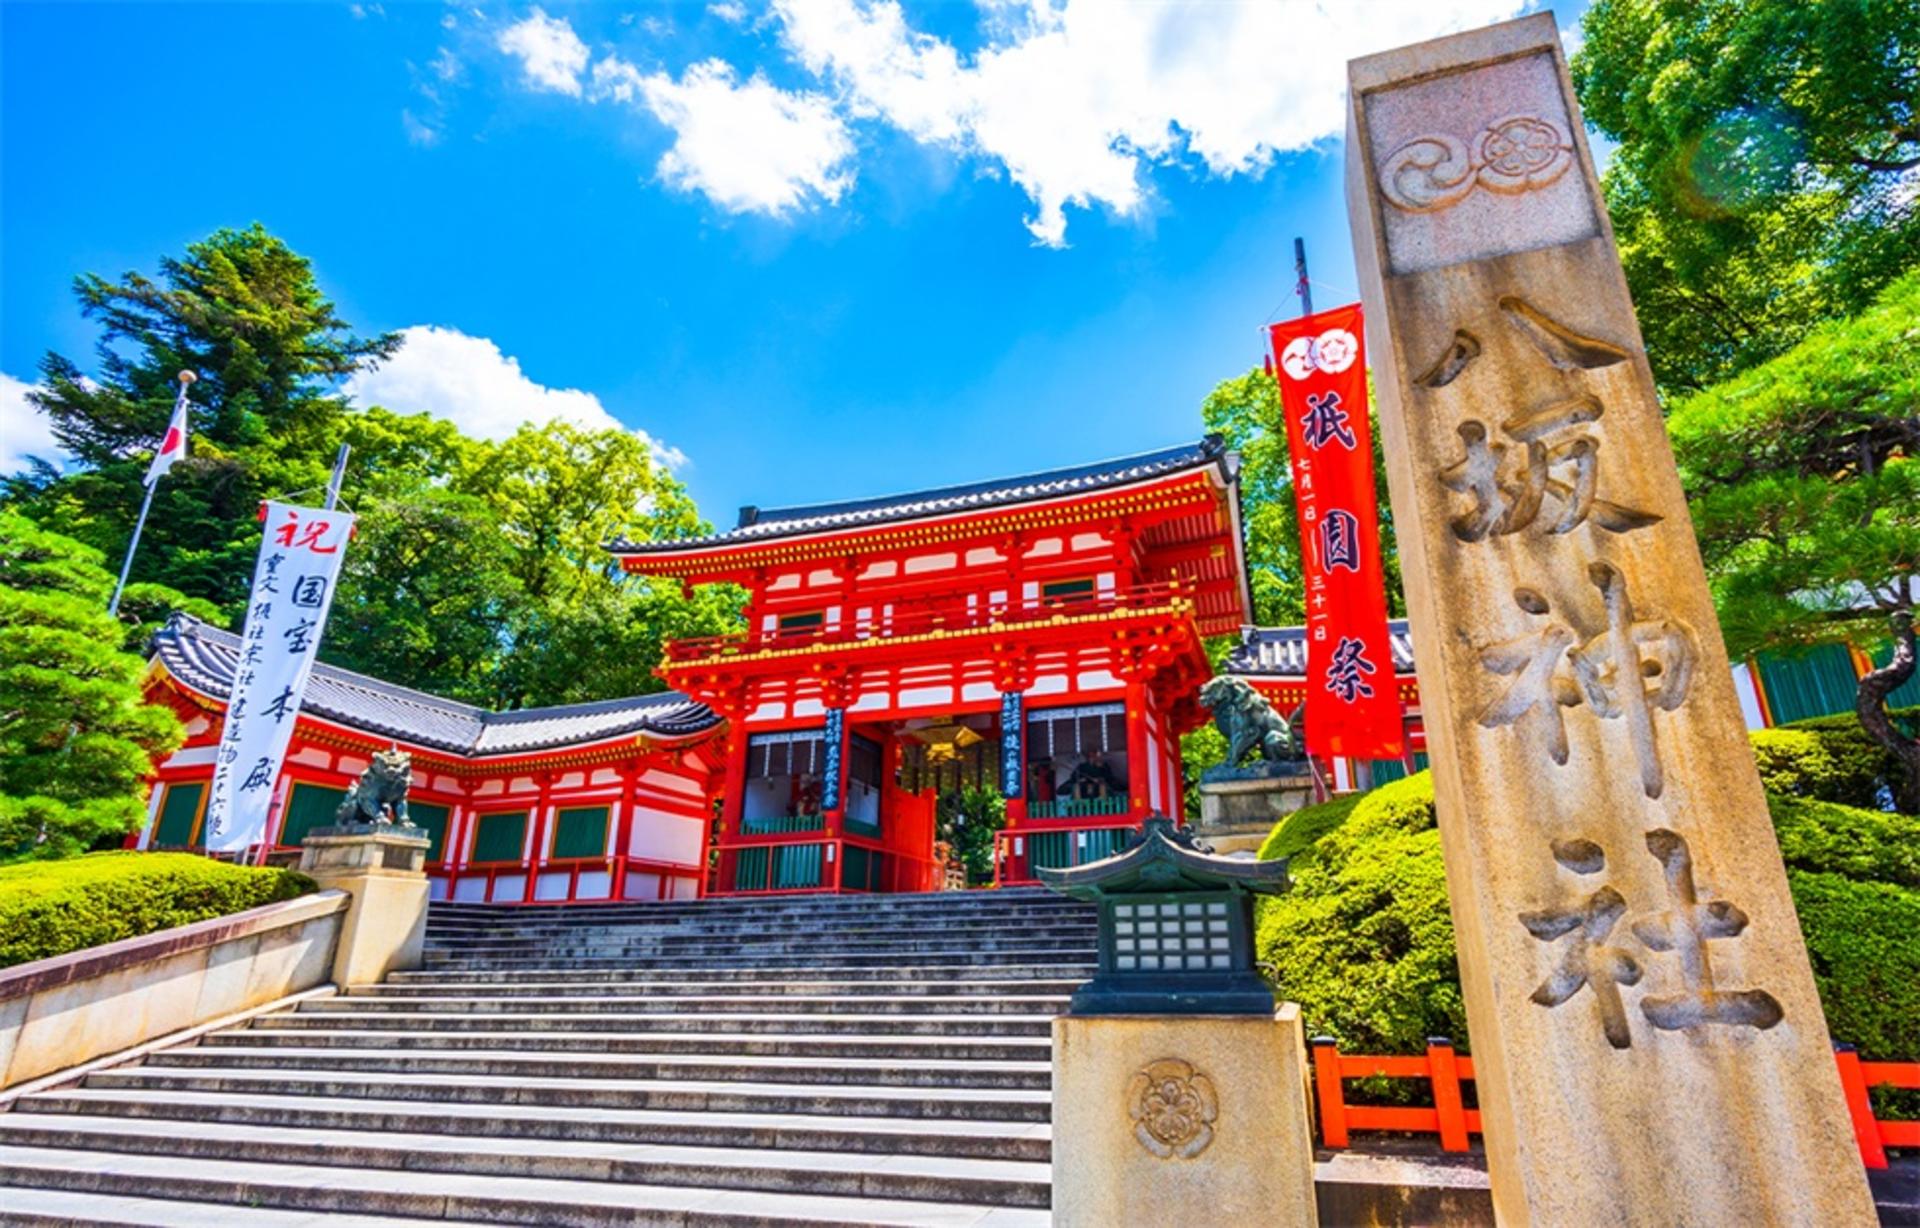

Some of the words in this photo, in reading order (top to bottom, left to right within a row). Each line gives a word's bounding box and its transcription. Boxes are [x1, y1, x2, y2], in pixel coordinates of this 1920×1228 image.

[275, 511, 338, 554] 祝
[1300, 390, 1376, 703] 祇園祭
[240, 576, 327, 793] 国宝本殿
[1411, 299, 1785, 1049] 八坂神社
